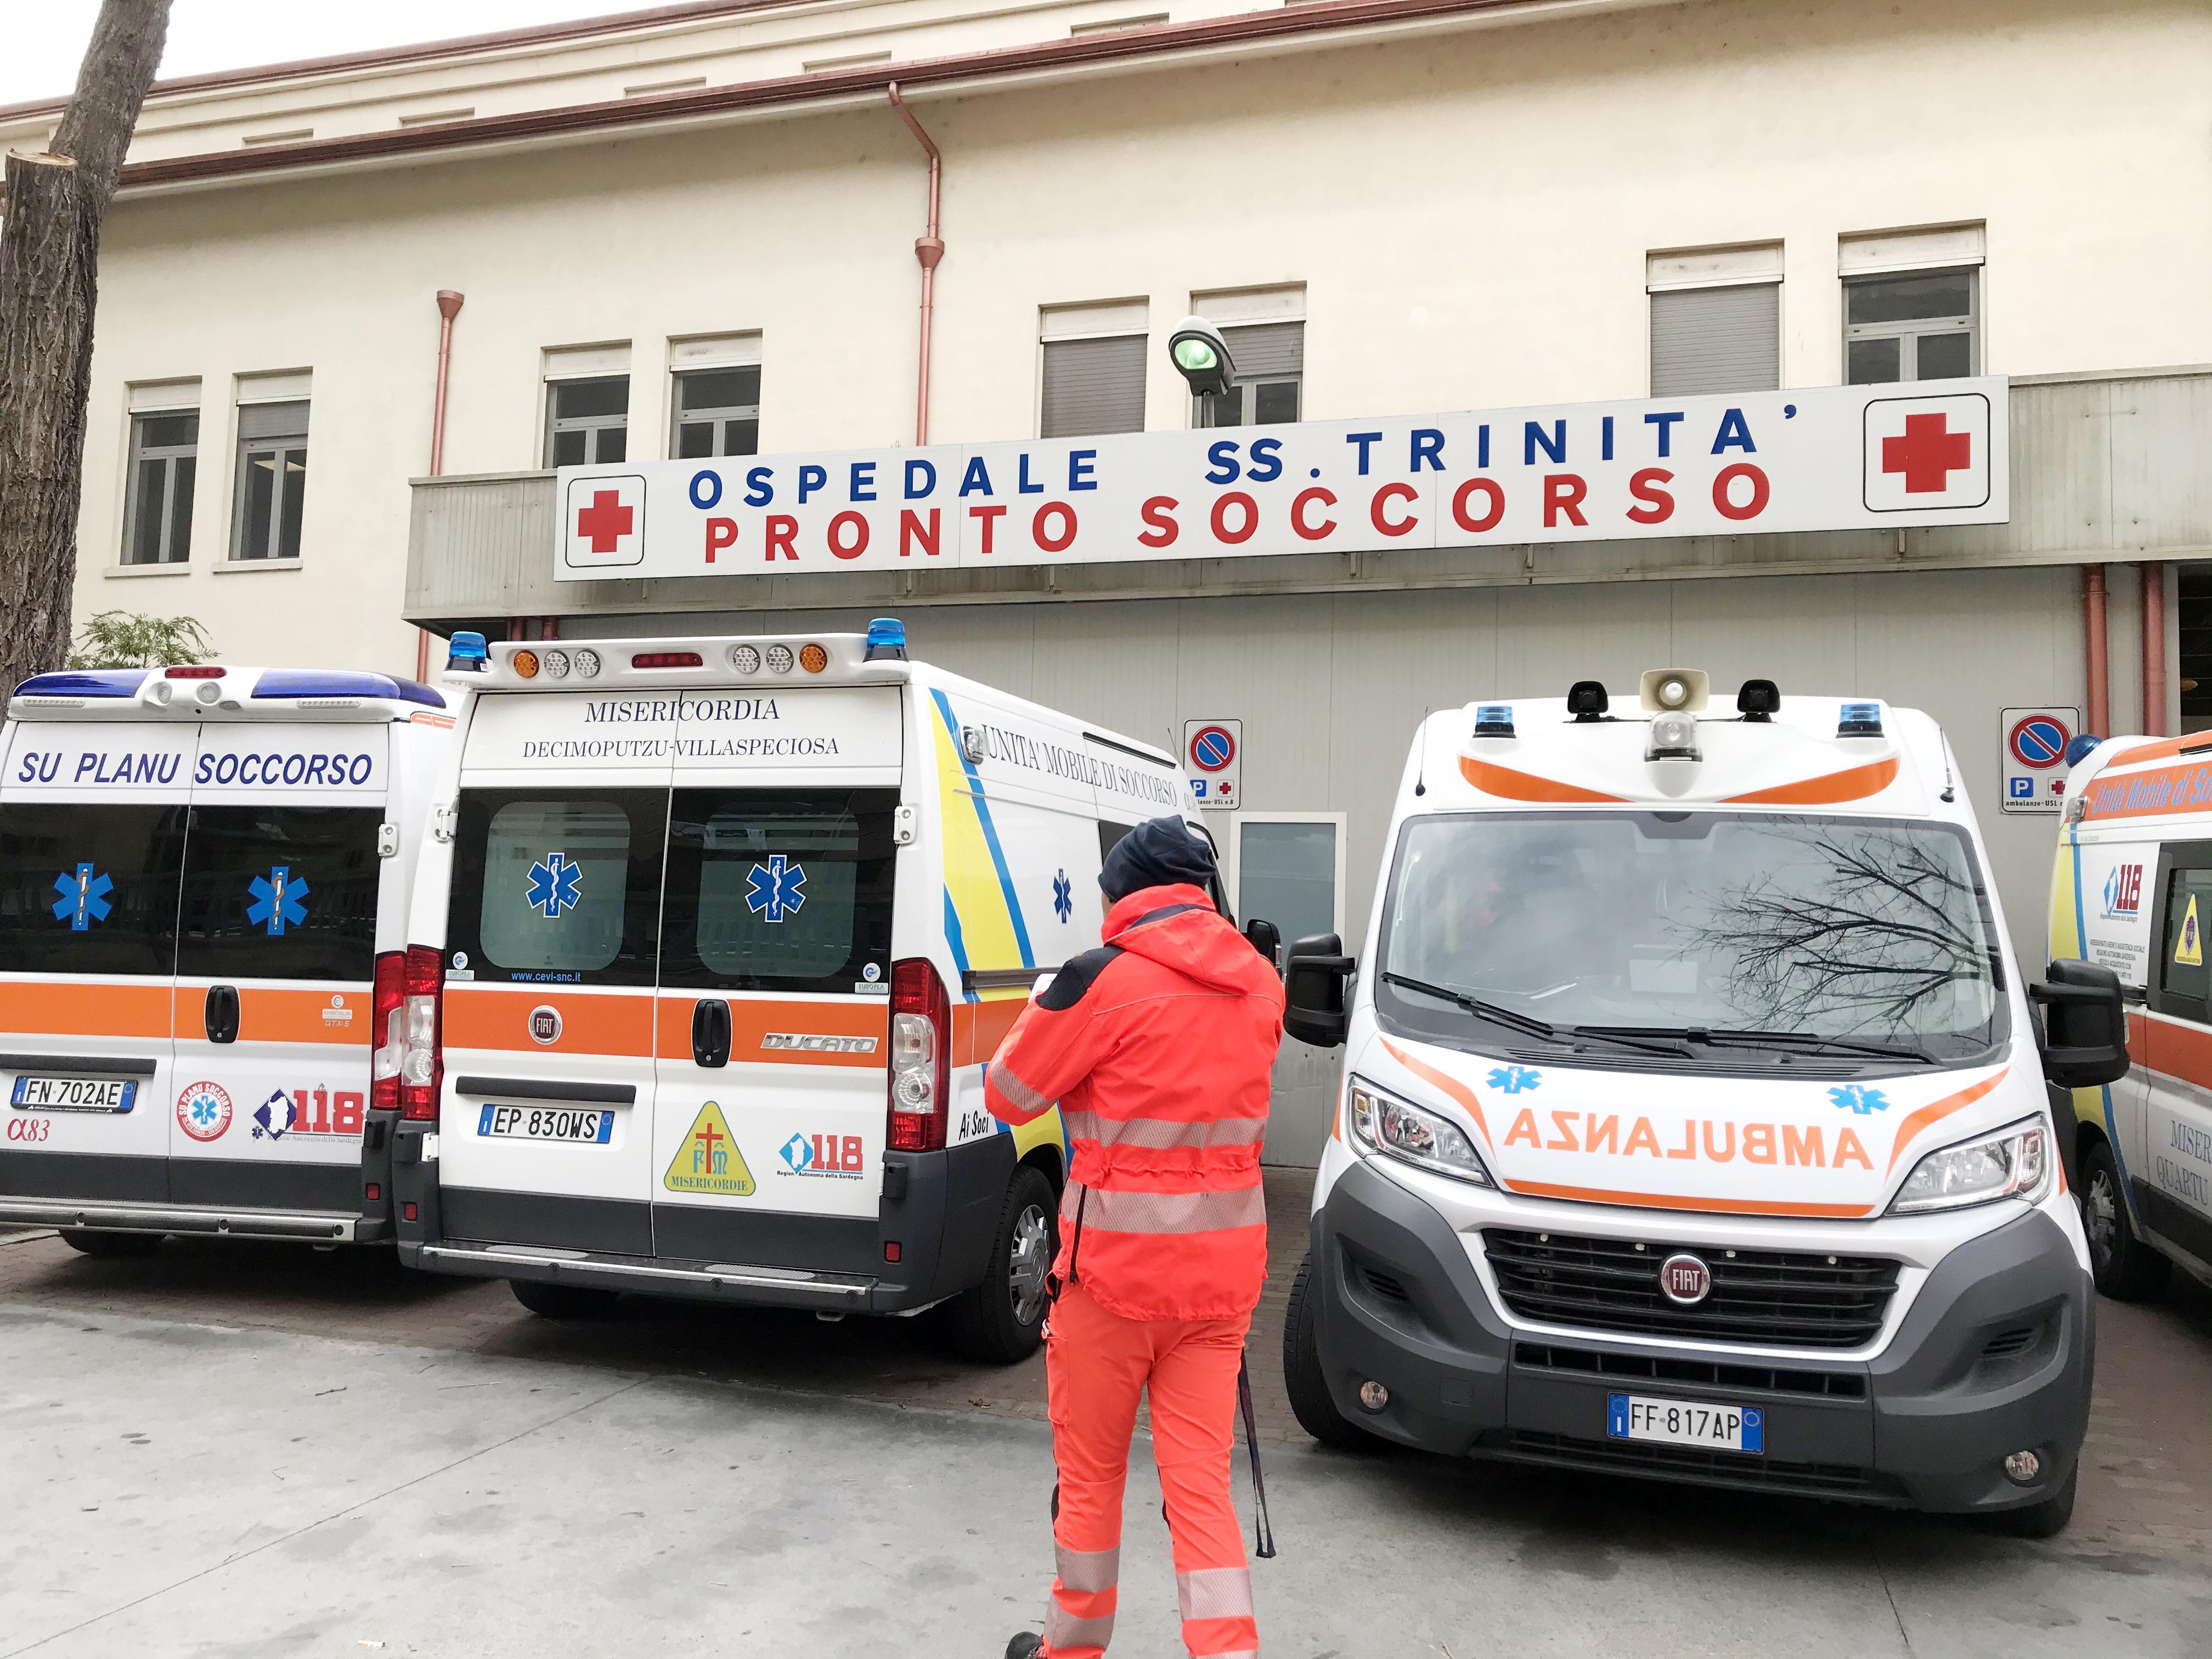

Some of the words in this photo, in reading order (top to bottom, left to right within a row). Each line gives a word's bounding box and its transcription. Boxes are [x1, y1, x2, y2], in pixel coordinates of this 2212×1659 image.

[689, 449, 1097, 510] OSPEDALE
[705, 501, 1077, 563] PRONTO
[1137, 462, 1770, 548] SOCCORSO
[585, 698, 780, 723] MISERICORDIA
[522, 738, 839, 758] DECIMOPUTZU-VILLASPECIOSA
[18, 752, 63, 782] SU
[74, 753, 182, 783] PLANU
[195, 753, 373, 785] SOCCORSO
[1042, 743, 1102, 787] MOBILE
[1101, 763, 1120, 792] DI
[1120, 767, 1177, 807] SOCCORSO
[2016, 780, 2029, 795] P
[2117, 865, 2142, 910] 118
[511, 972, 581, 981] www.cevi-snc.it
[536, 1018, 554, 1034] FIAT
[761, 1035, 876, 1052] DUCATO
[26, 1081, 53, 1103] FN
[57, 1081, 121, 1105] 702AE
[292, 1090, 364, 1134] 118
[494, 1108, 522, 1133] EP
[528, 1111, 597, 1139] 830WS
[958, 1113, 970, 1141] Ai
[811, 1134, 863, 1172] 118
[671, 1176, 748, 1190] MISERICORDIE
[2157, 1155, 2208, 1206] QUARTU
[1672, 1268, 1700, 1291] FIAT
[1631, 1403, 1658, 1431] FF
[1667, 1407, 1740, 1440] 817AP
